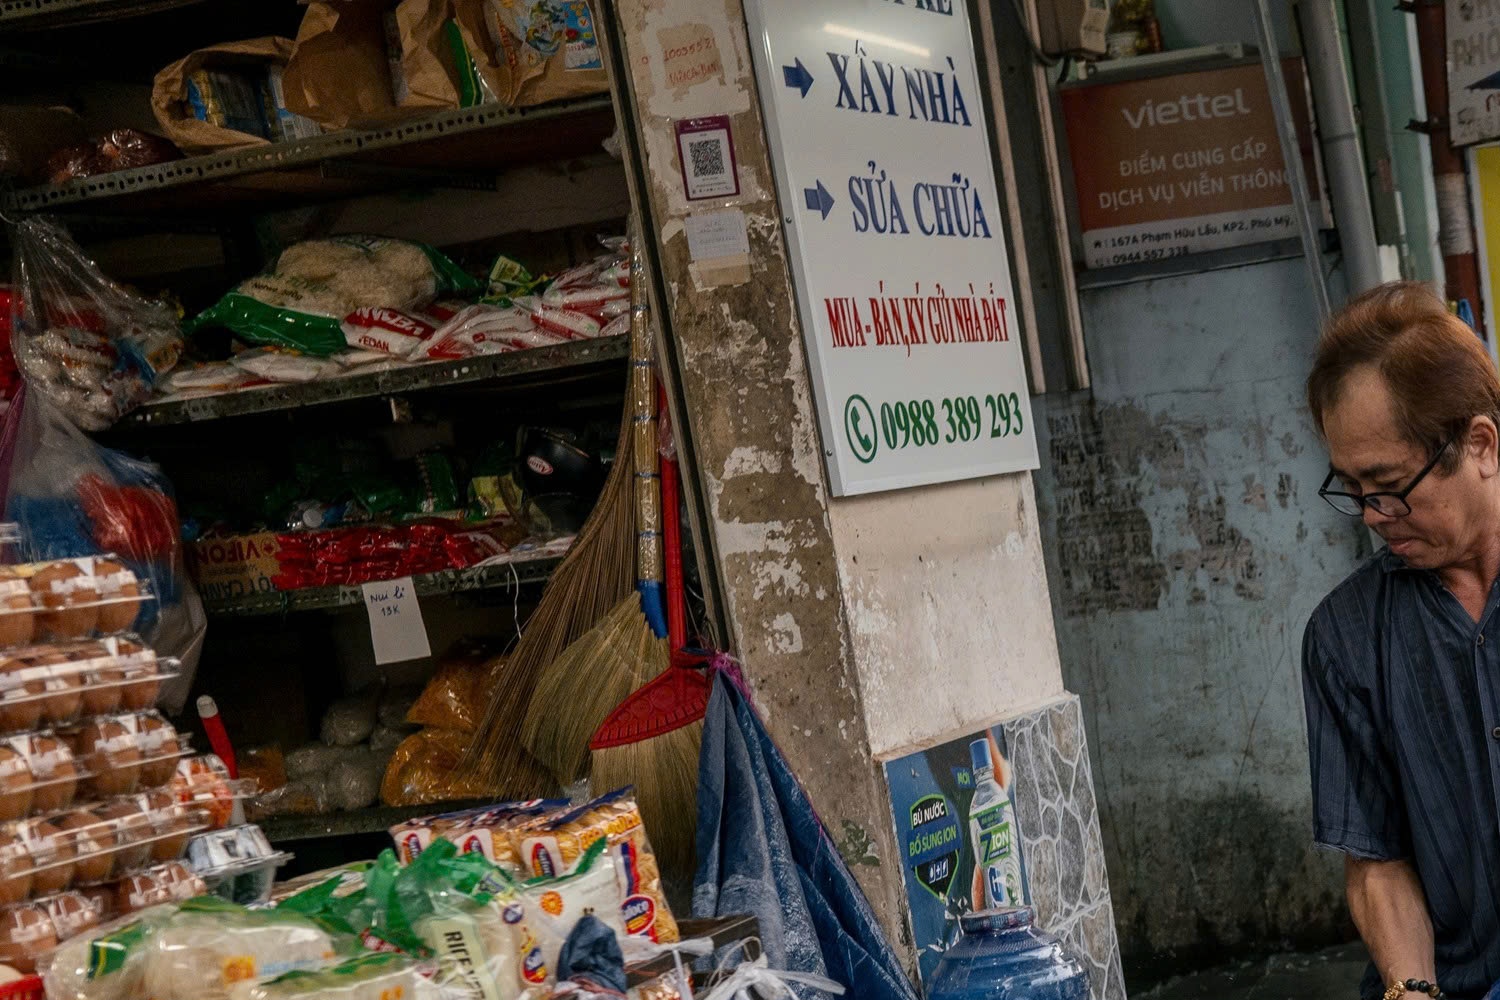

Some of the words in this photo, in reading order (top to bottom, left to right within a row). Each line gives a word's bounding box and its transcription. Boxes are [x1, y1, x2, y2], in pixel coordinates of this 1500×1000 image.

[827, 39, 898, 117] XÂY
[901, 56, 972, 126] NHÀ
[1172, 148, 1225, 170] CUNG
[1231, 138, 1267, 162] CẤP
[848, 160, 910, 234] SỬA
[913, 172, 992, 238] CHỮA
[1099, 189, 1144, 211] DỊCH
[1149, 184, 1175, 204] VỤ
[880, 399, 940, 450] 0988
[941, 396, 981, 444] 389
[985, 392, 1024, 439] 293
[913, 806, 923, 827] BÙ
[924, 801, 945, 820] NƯỚC
[909, 832, 921, 857] BỔ
[922, 830, 943, 852] SUNG
[943, 824, 957, 844] ION
